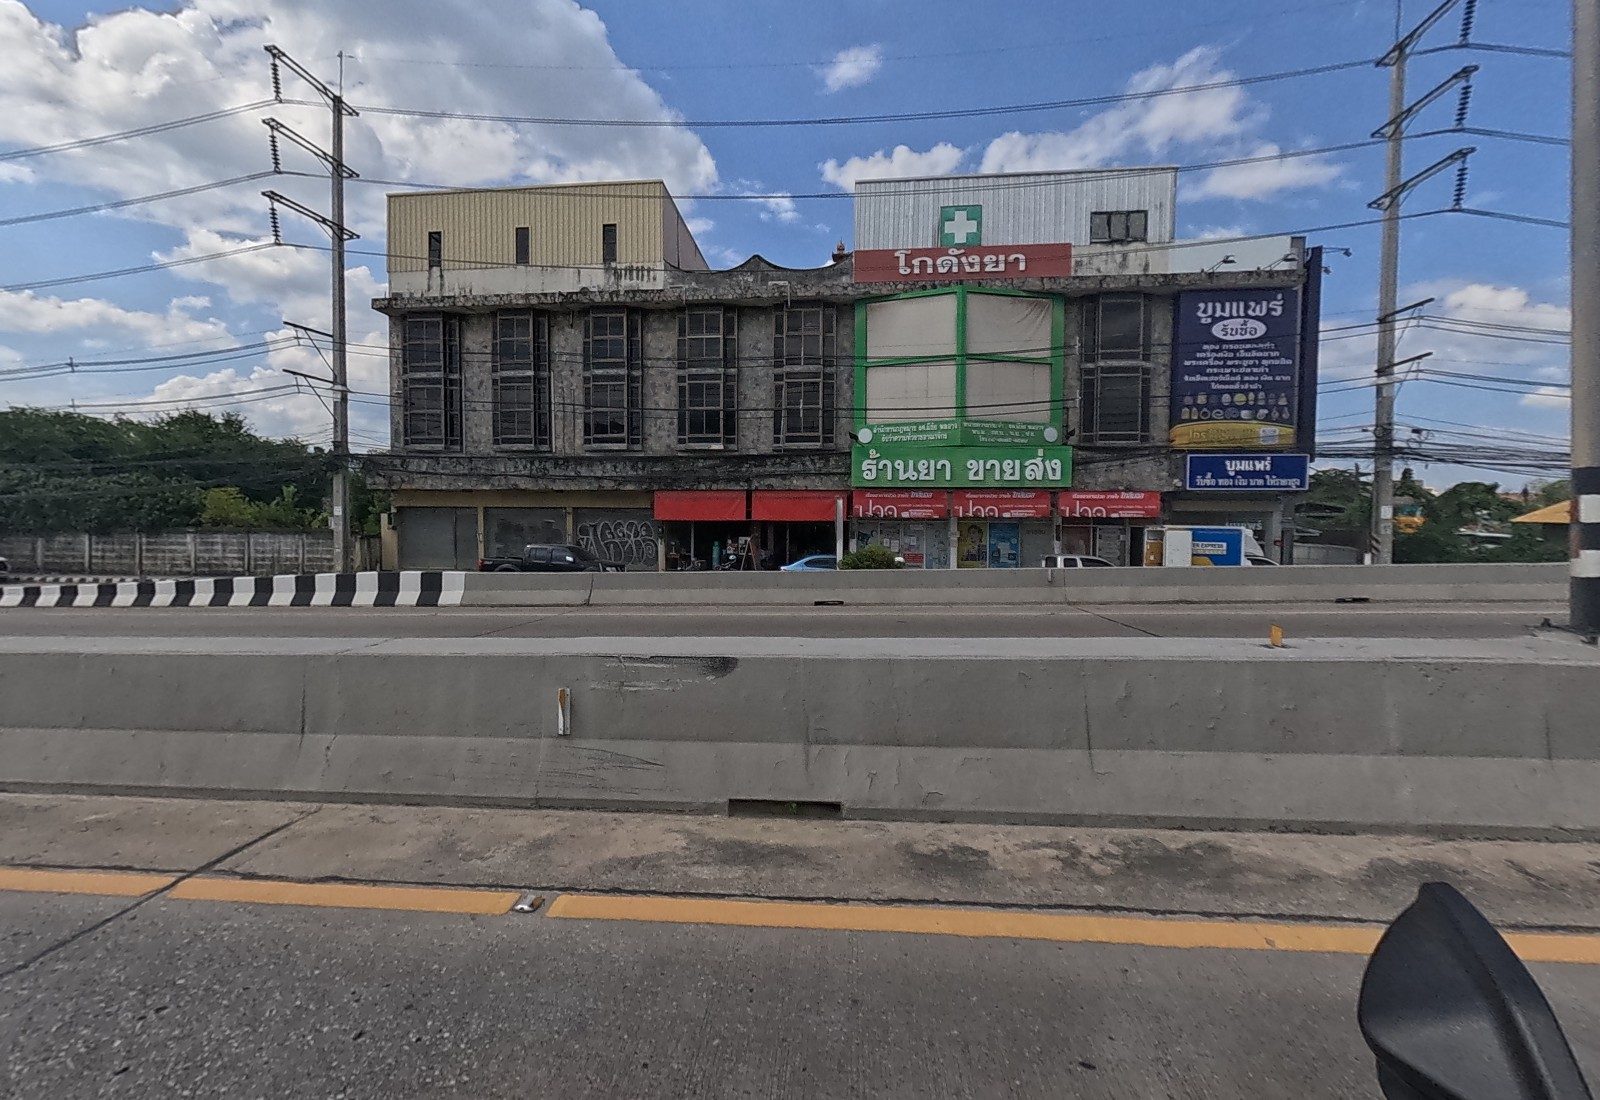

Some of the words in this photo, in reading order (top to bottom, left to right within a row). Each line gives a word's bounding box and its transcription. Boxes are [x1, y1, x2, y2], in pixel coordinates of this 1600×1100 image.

[894, 248, 1026, 275] โกดังยา
[1196, 293, 1284, 324] บูมแพร่
[1220, 319, 1258, 337] รับซื้อ
[861, 449, 951, 481] ร้านยา
[967, 449, 1062, 481] ขายส่ง
[1225, 457, 1272, 476] บูมแพร่
[1196, 472, 1216, 486] รับซื้อ
[1218, 478, 1233, 486] ทอง
[1234, 476, 1248, 486] เงิน
